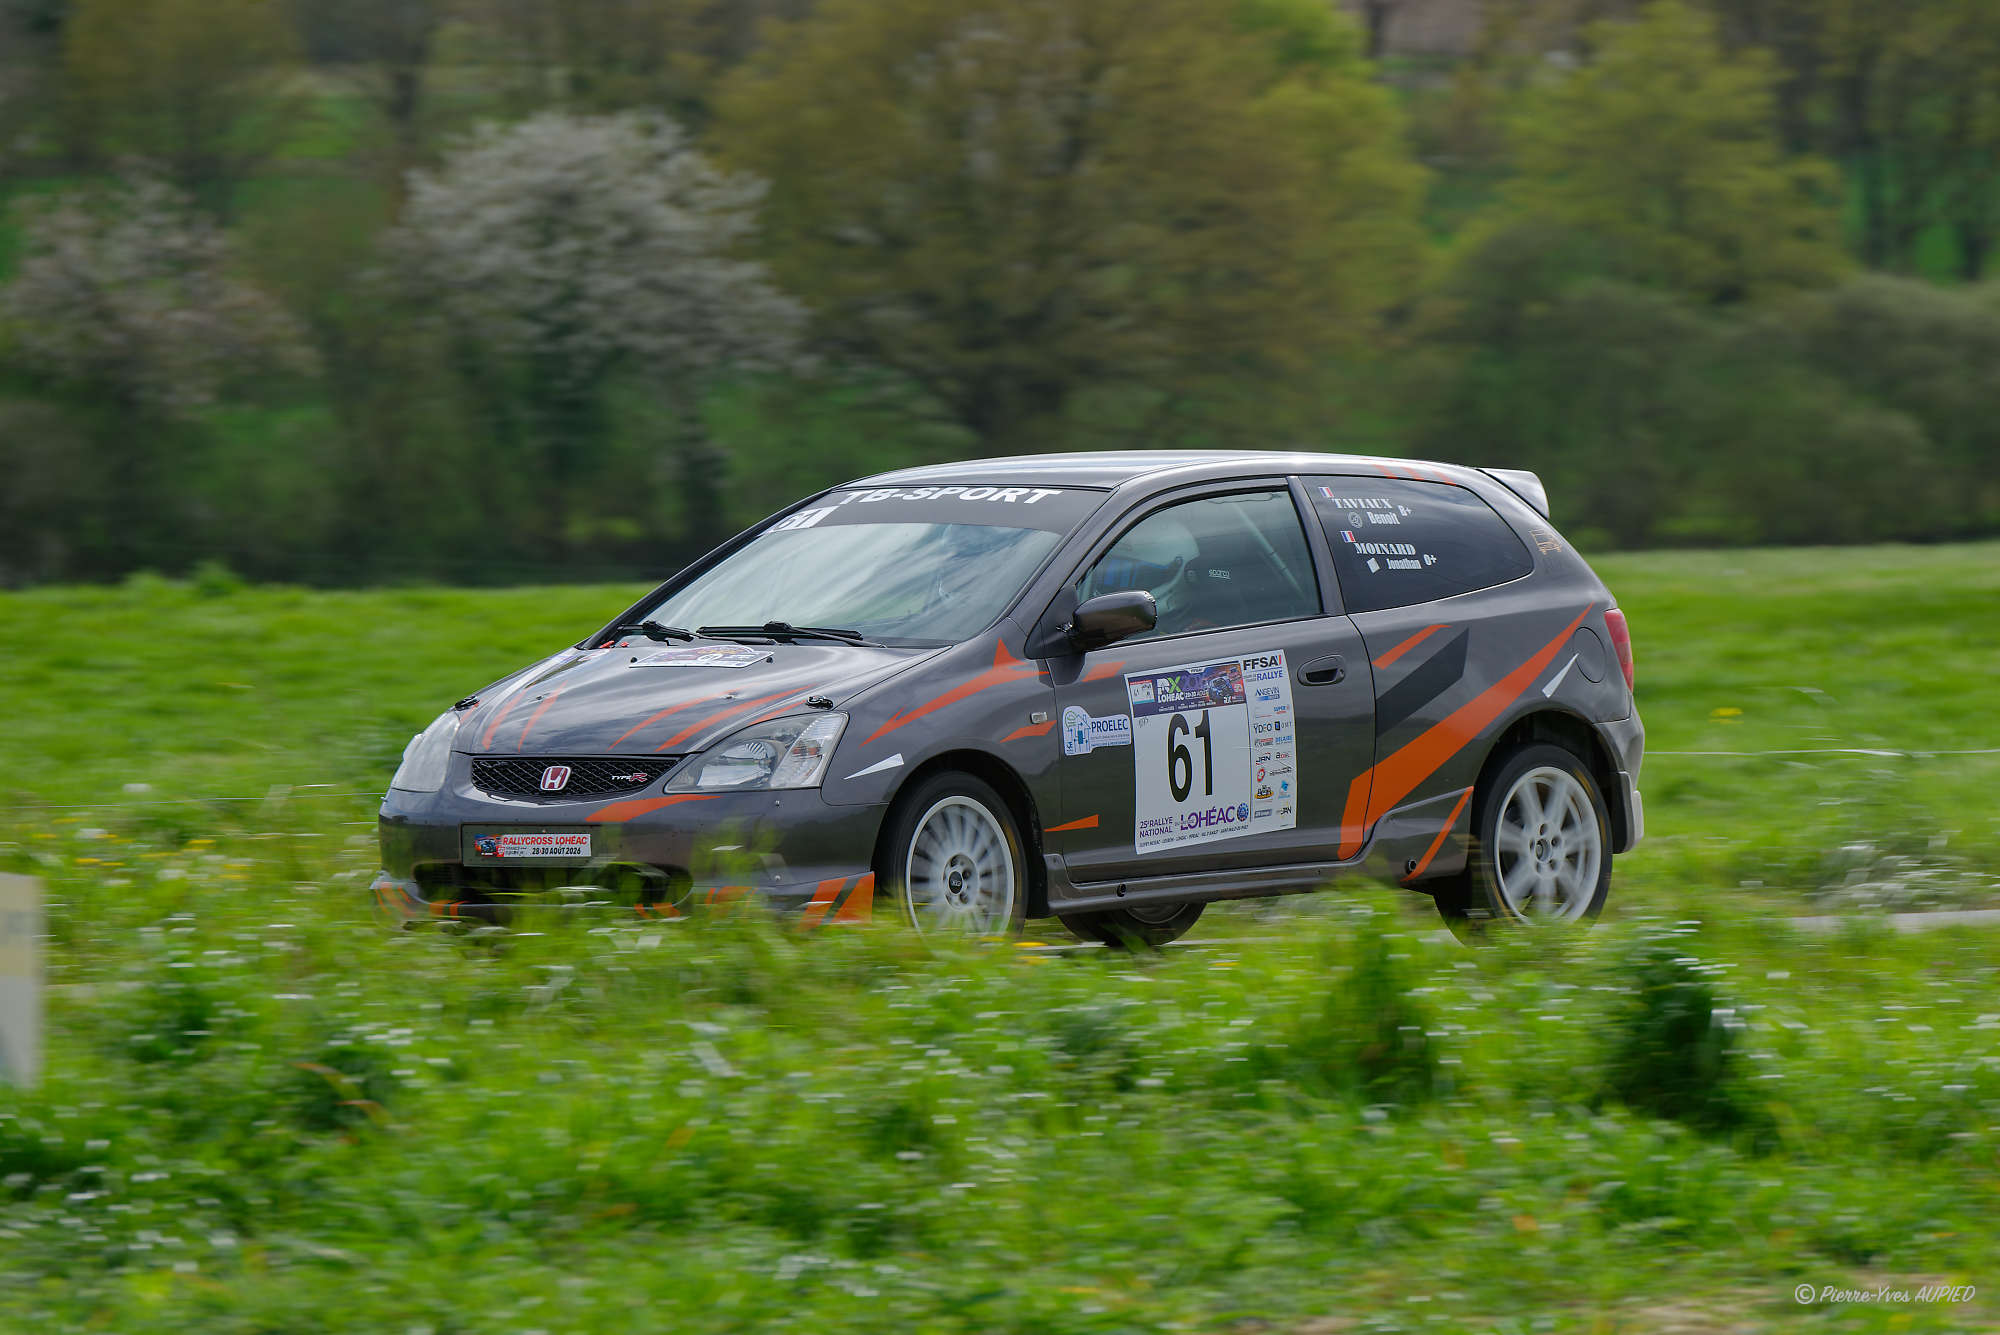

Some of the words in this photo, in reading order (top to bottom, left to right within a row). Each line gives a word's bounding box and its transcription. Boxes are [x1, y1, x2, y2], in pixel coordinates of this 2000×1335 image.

[839, 487, 1063, 504] TB-SPORT
[1332, 498, 1393, 509] TAVIAUX
[1353, 542, 1416, 555] MOINARD
[1243, 655, 1279, 671] FFSA
[1256, 670, 1284, 681] RALLYE
[1091, 718, 1129, 733] PROELEC
[1167, 709, 1213, 802] 61
[629, 772, 648, 782] R
[1149, 816, 1173, 827] RALLYE
[1180, 805, 1235, 831] LOHÉAC
[1139, 826, 1173, 838] NATIONAL
[503, 836, 552, 846] RALLYCROSS
[555, 835, 588, 845] LOHÉAC
